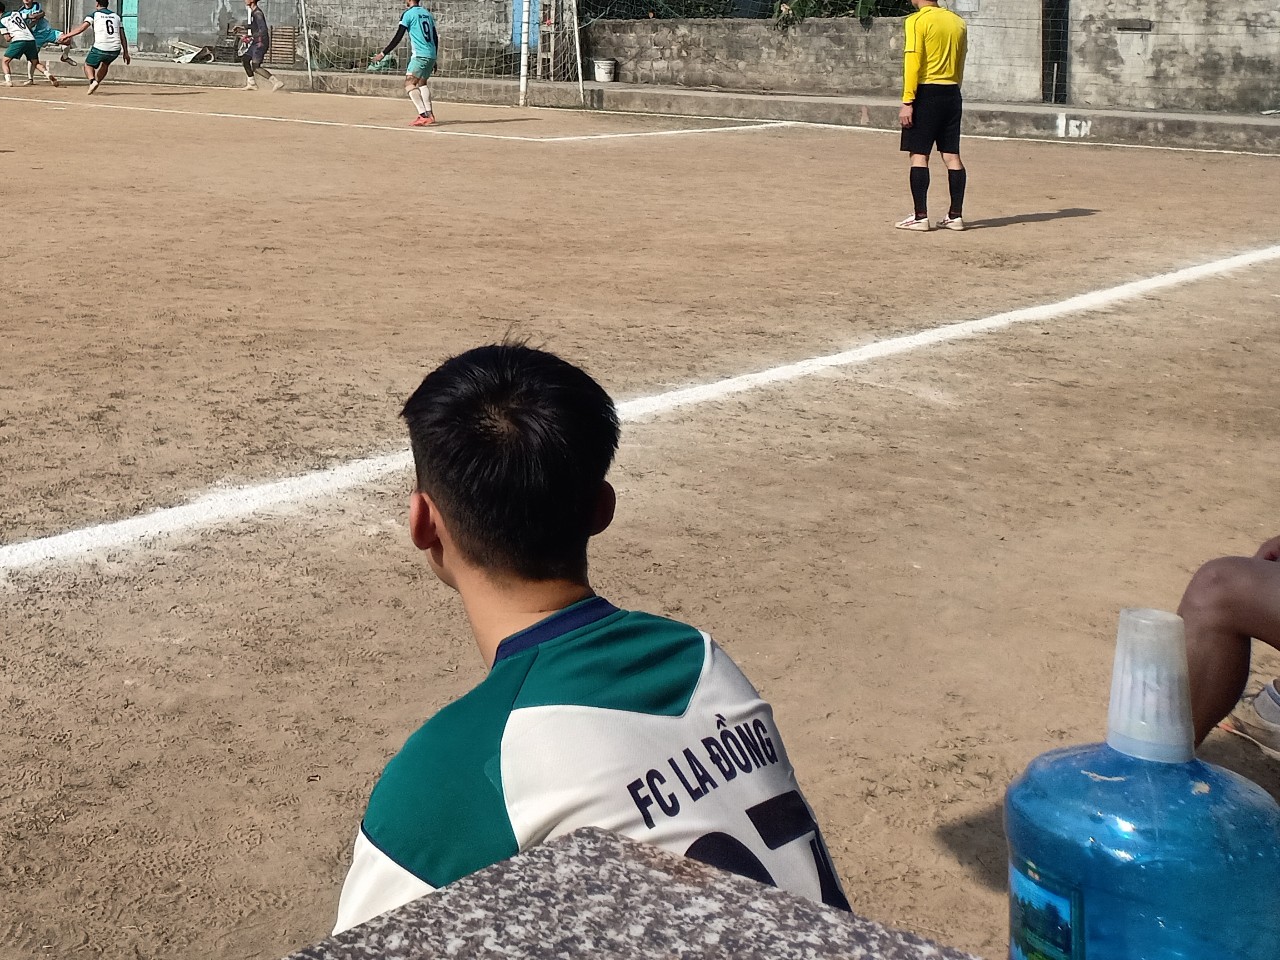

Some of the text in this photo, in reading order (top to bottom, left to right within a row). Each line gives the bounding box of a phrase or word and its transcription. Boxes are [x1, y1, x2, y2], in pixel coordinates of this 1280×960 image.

[11, 16, 27, 31] 18
[105, 19, 115, 36] 6
[421, 20, 432, 43] 9
[626, 713, 780, 830] FC LA ĐỒNG
